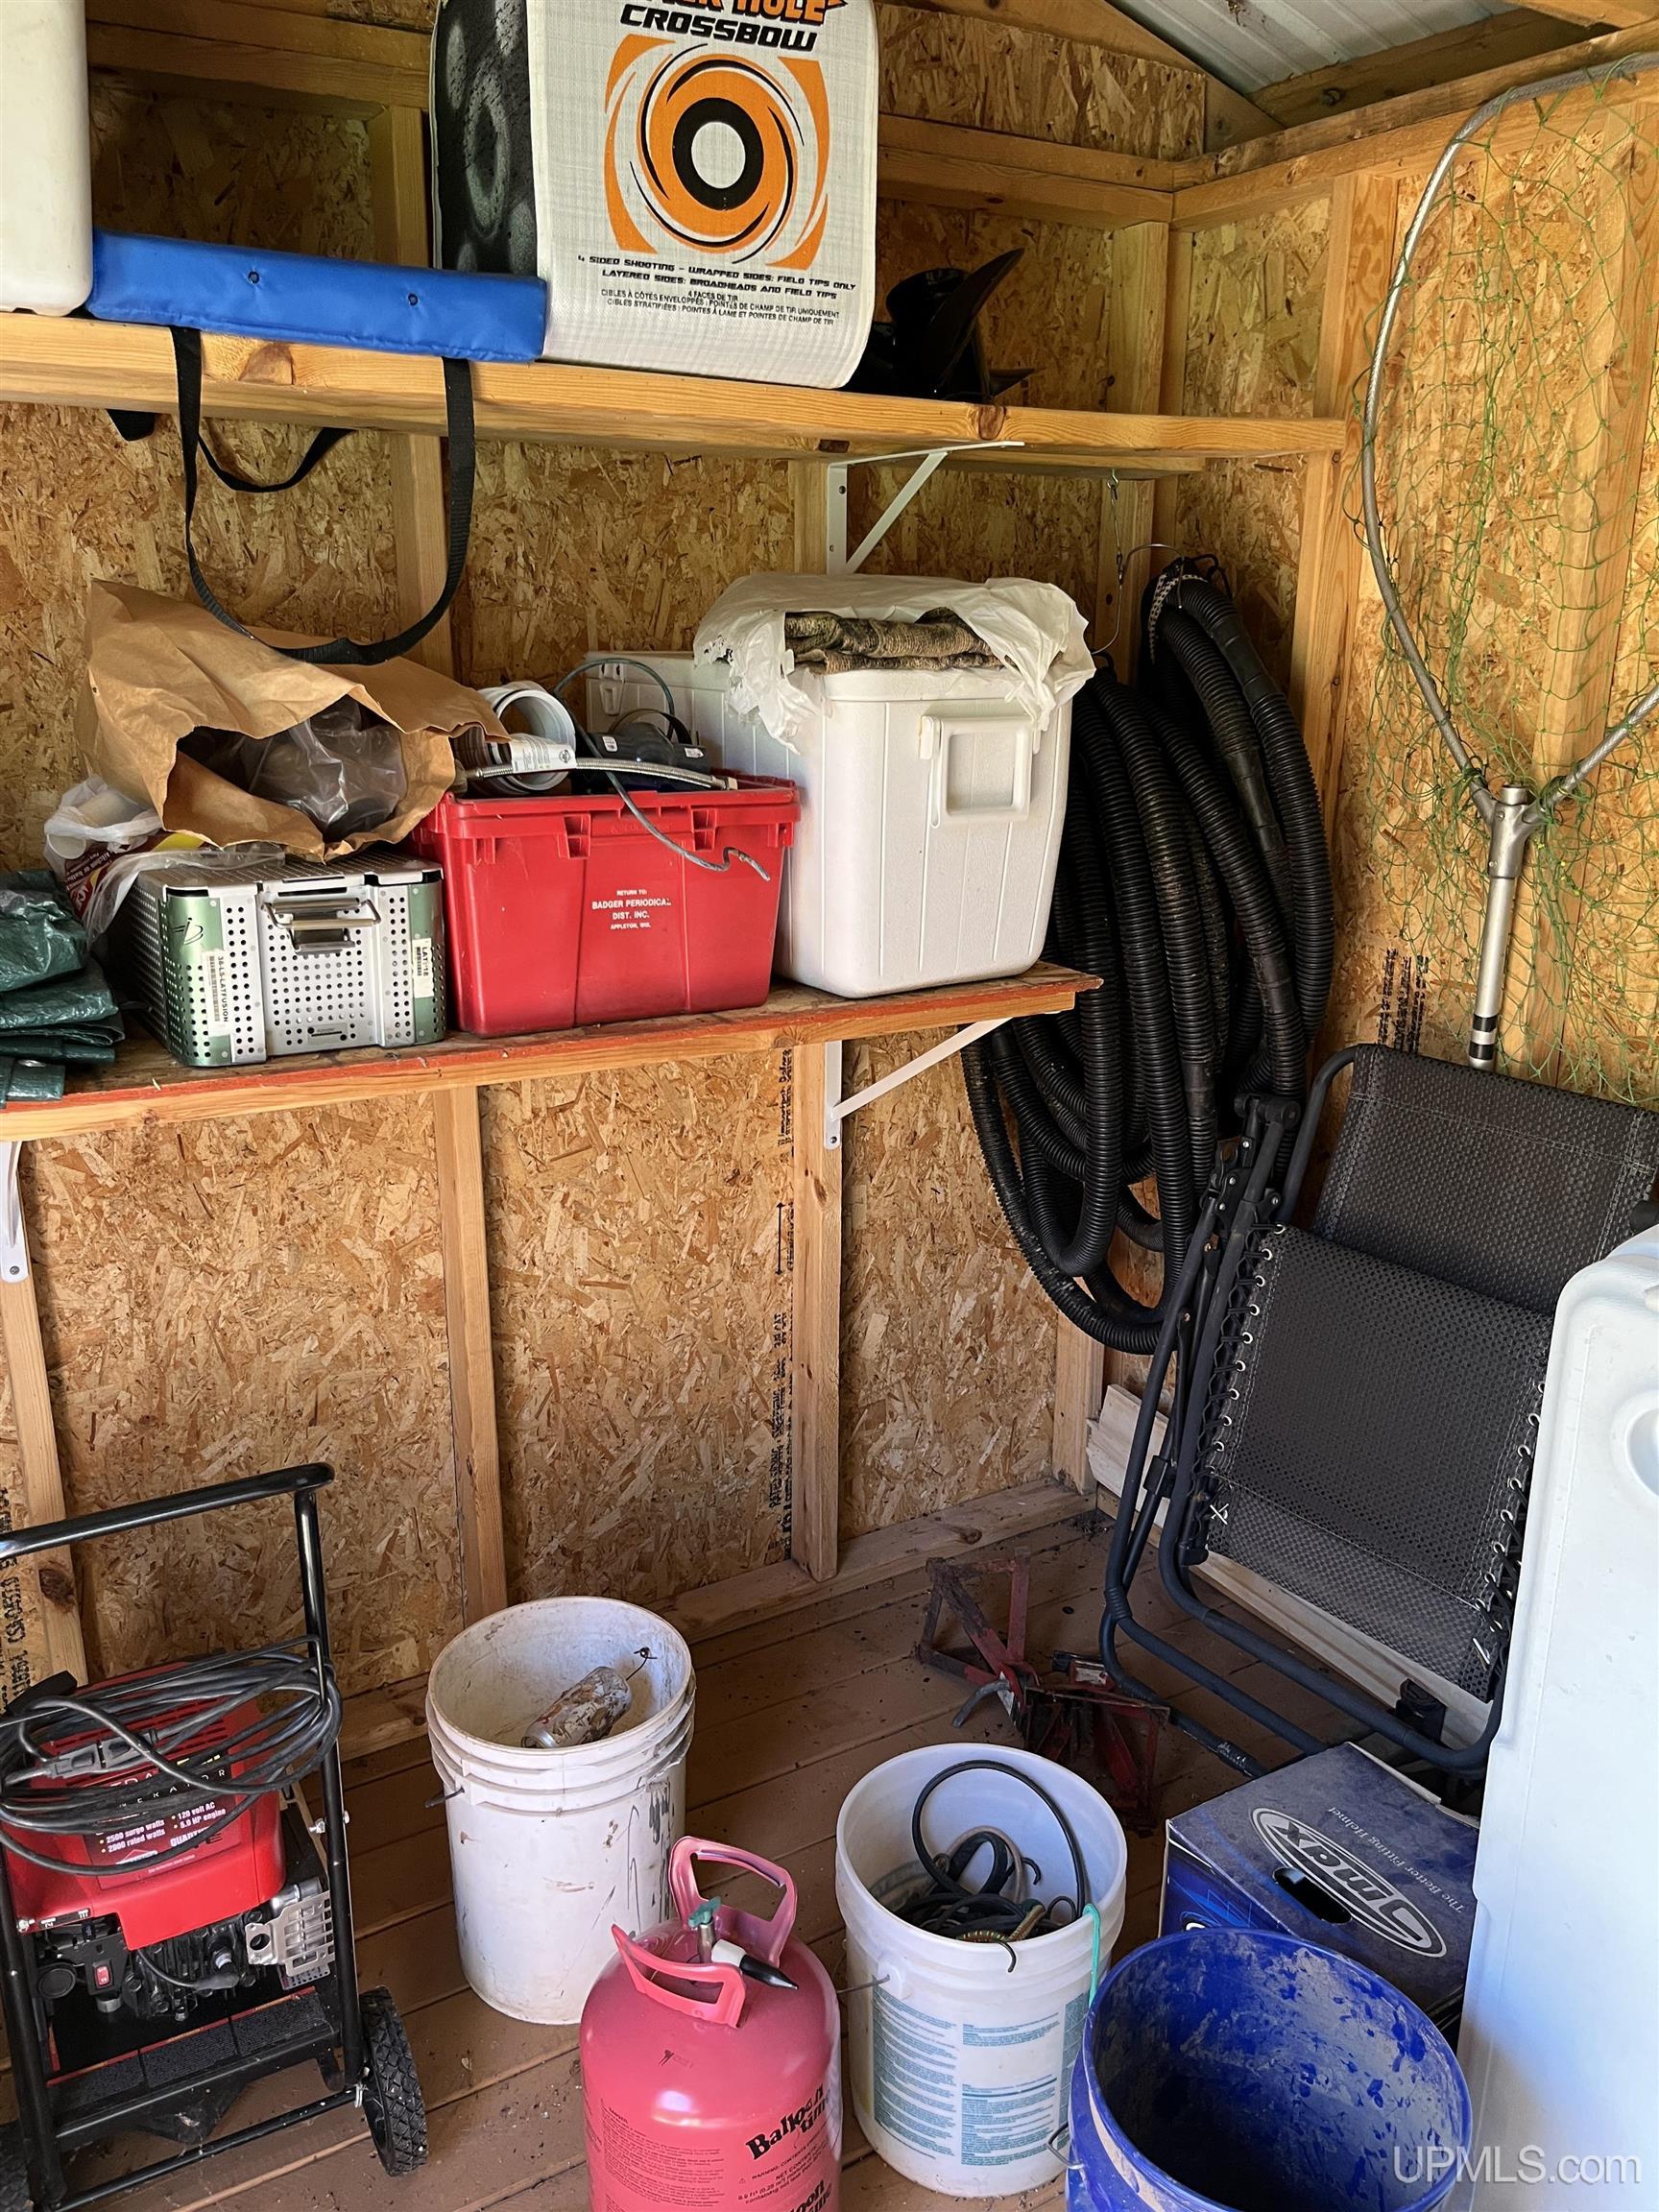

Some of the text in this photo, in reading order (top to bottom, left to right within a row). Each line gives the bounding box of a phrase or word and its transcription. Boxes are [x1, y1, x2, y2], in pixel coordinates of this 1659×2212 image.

[620, 4, 818, 52] CROSSBOW
[589, 255, 620, 265] SIDED
[624, 258, 675, 272] SHOOTING
[688, 266, 739, 279] WRAPPED
[743, 272, 774, 281] SIDES:
[777, 276, 805, 284] FIELD
[809, 278, 830, 287] TIPS
[833, 281, 856, 291] ONLY
[602, 269, 650, 280] LAYERED
[654, 275, 686, 284] SIDES:
[689, 278, 757, 292] BROADHEADS
[784, 287, 812, 297] FIELD
[816, 290, 837, 300] TIPS
[601, 289, 626, 298] CIBLES
[709, 301, 737, 310] POINTES
[750, 303, 774, 312] CHAMP
[798, 307, 839, 319] UNIQUEMENT
[694, 291, 715, 300] FACES
[607, 299, 632, 307] CIBLES
[682, 305, 710, 315] POINTES
[719, 309, 736, 318] LAME
[749, 312, 777, 321] POINTES
[591, 898, 671, 910] BADGER PERIODICAL
[613, 910, 650, 921] DIST. INC.
[178, 1801, 216, 1820] 120 volt AC
[192, 1815, 202, 1826] HP
[203, 1808, 227, 1822] engine
[125, 1826, 145, 1839] surge
[145, 1819, 165, 1831] watts
[127, 1834, 146, 1846] rated
[146, 1829, 165, 1840] watts
[1328, 1807, 1466, 1913] The Better Fitting Helmet
[745, 2083, 824, 2160] Balloon
